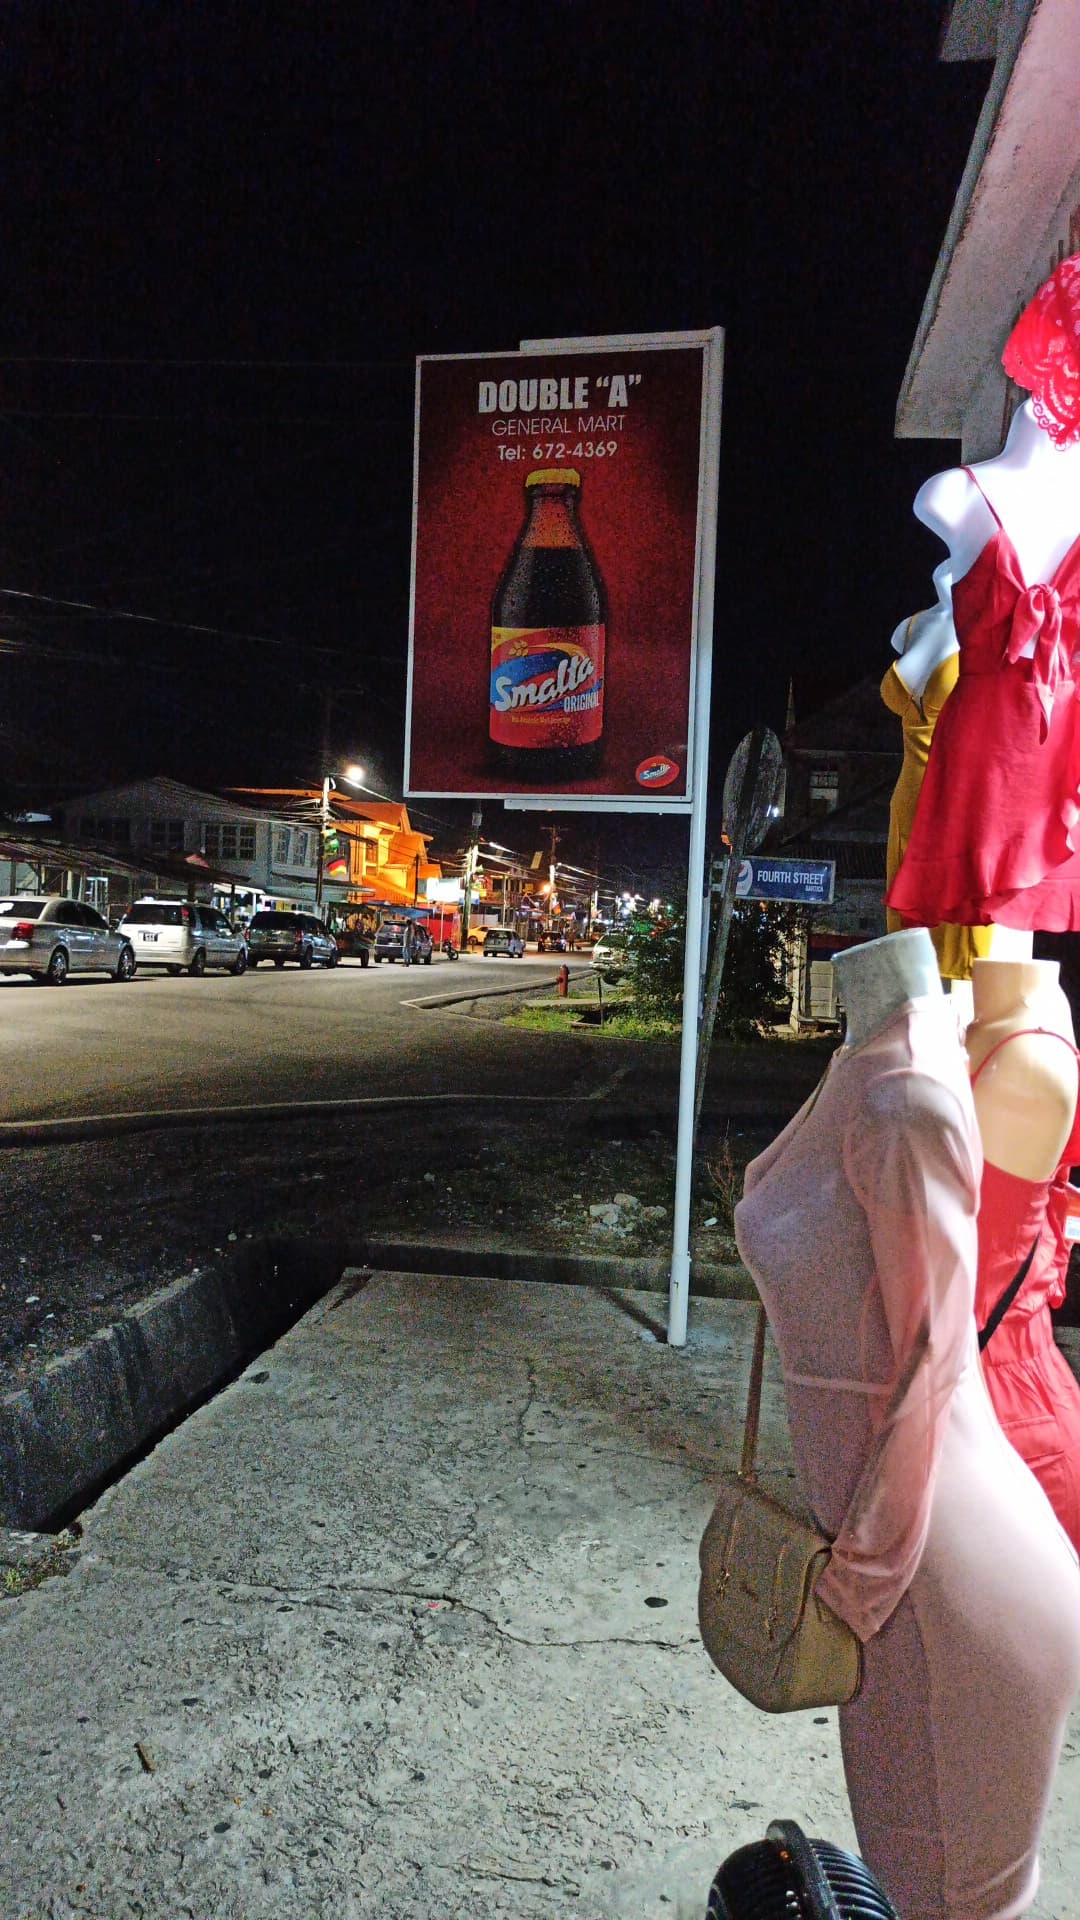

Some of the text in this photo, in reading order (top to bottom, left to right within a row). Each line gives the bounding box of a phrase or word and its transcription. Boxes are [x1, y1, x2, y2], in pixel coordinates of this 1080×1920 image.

[478, 377, 589, 413] DOUBLE
[491, 414, 627, 436] GENERAL MART
[498, 441, 618, 461] Tel: 672-4369
[494, 653, 595, 712] Smalta
[563, 691, 600, 713] ORIGINAL
[757, 870, 825, 885] FOURTH STREET
